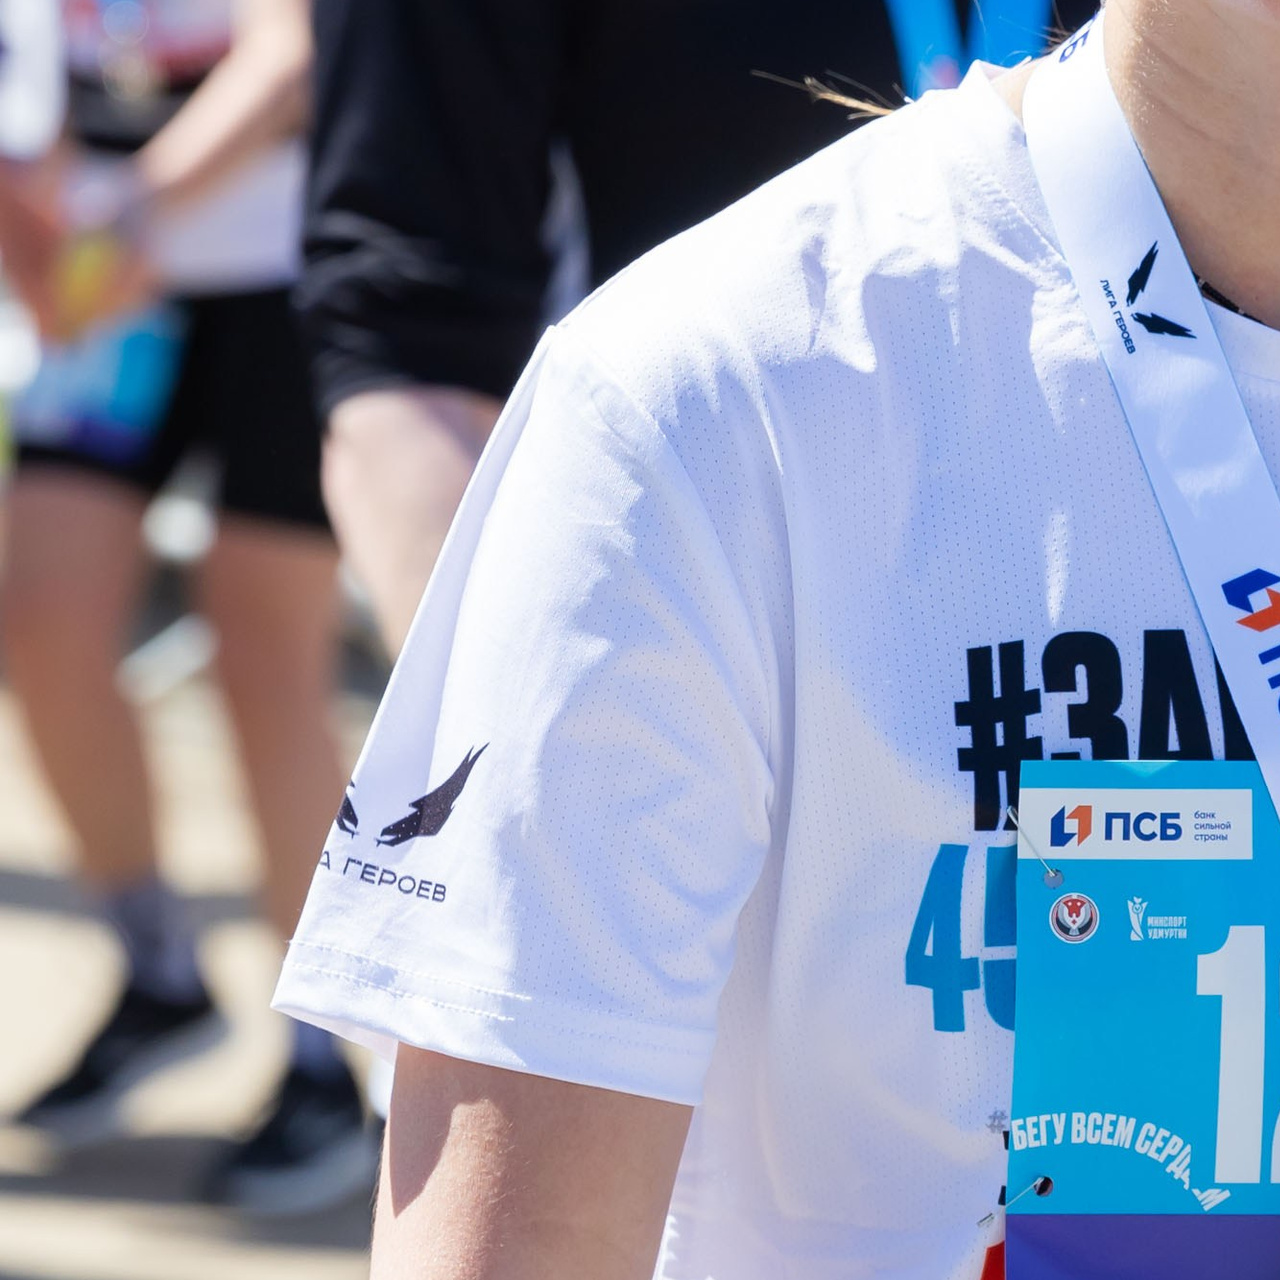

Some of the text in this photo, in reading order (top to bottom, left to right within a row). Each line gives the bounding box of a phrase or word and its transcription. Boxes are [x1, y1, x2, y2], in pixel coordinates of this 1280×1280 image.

[1100, 279, 1136, 355] ЛИГА ГЕРОЕВ
[1104, 811, 1183, 841] ПСБ
[1194, 810, 1216, 819] банк
[1194, 820, 1232, 830] сильной
[1194, 833, 1228, 842] страны
[343, 857, 447, 903] ГЕРОЕВ
[1011, 1113, 1066, 1151] БЕГУ
[1071, 1112, 1136, 1149] ВСЕМ
